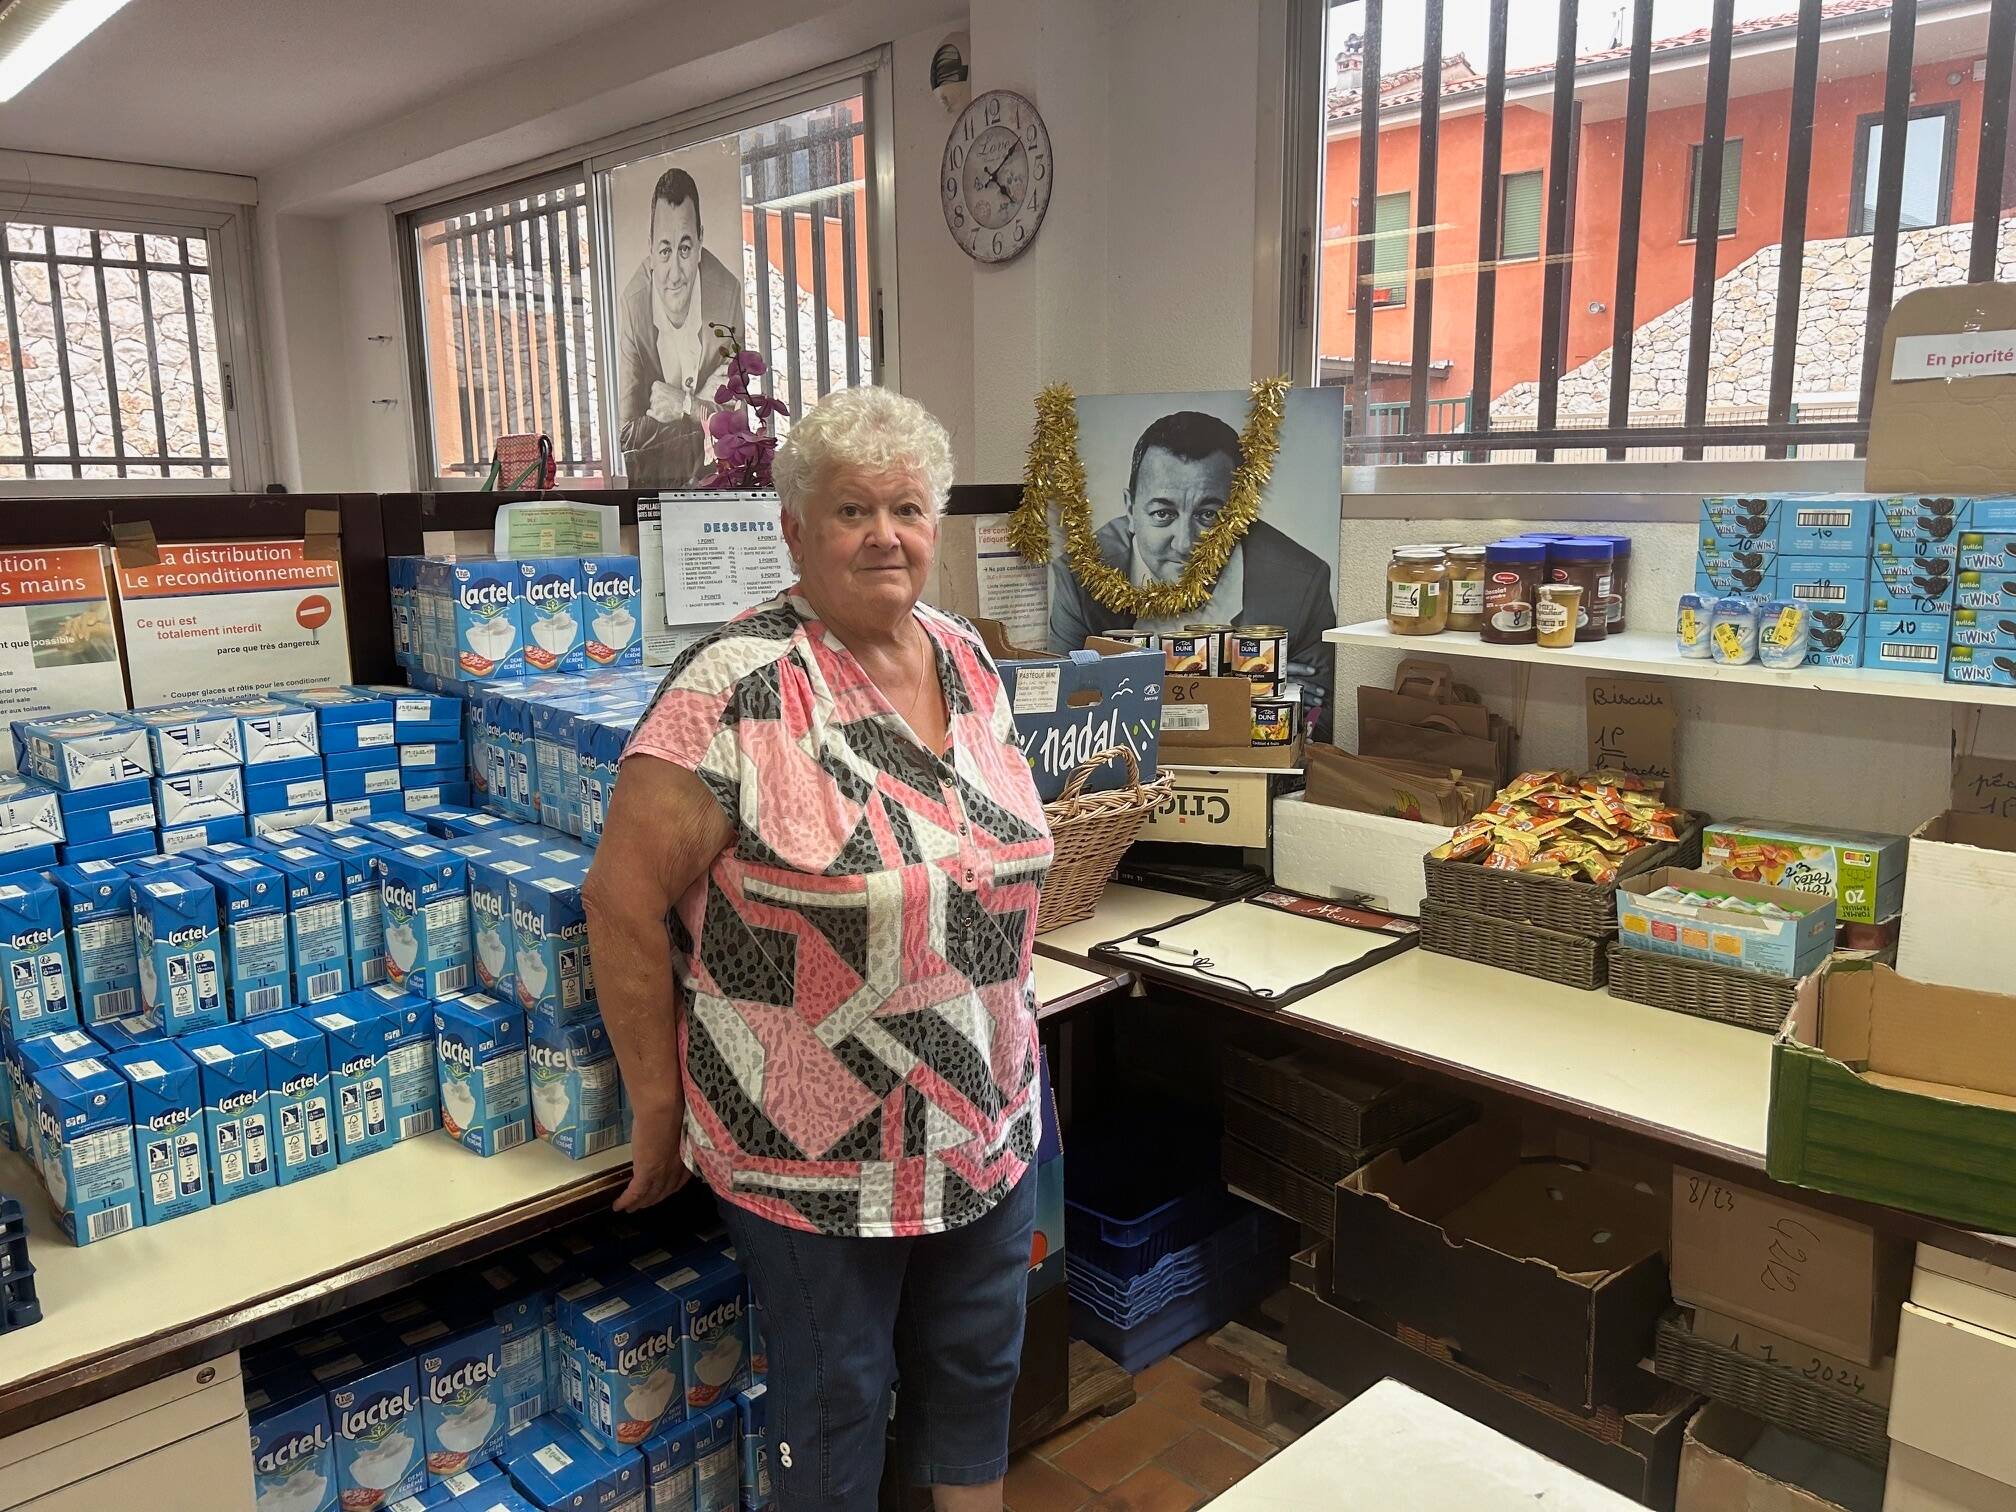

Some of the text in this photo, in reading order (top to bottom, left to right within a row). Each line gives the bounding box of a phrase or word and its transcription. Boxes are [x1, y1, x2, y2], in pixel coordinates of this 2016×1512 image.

[984, 98, 1000, 126] 12
[1015, 104, 1021, 129] 1
[964, 117, 974, 141] 11
[1026, 124, 1038, 150] 2
[950, 145, 963, 171] 10
[1033, 154, 1045, 181] 3
[947, 177, 957, 200] 9
[1027, 185, 1038, 212] 4
[953, 205, 964, 228] 8
[971, 227, 981, 251] 7
[1013, 219, 1024, 241] 5
[992, 232, 1002, 256] 6
[1926, 347, 2014, 367] En priorité
[1712, 505, 1736, 515] TWINS
[1889, 506, 1918, 516] TWINS
[704, 521, 774, 533] DESSERTS
[1717, 524, 1736, 534] WINS
[1811, 528, 1833, 539] 10
[1893, 528, 1917, 538] WINS
[1728, 538, 1752, 550] 10
[1915, 543, 1927, 556] 10
[183, 546, 291, 565] distribution
[1708, 558, 1733, 568] TWINS
[1964, 554, 2004, 569] TWINS
[125, 564, 334, 588] Le reconditionnement
[1884, 566, 1912, 575] TWINS
[20, 577, 86, 593] mains
[588, 576, 636, 601] lactel
[1712, 577, 1732, 587] WINS
[1889, 585, 1911, 594] WINS
[1959, 581, 1980, 589] gullón
[460, 582, 516, 610] lactel
[526, 578, 577, 605] lactel
[1411, 588, 1418, 606] 6
[1960, 592, 2000, 607] TWINS
[137, 616, 197, 628] Ce qui est
[1514, 610, 1521, 625] 8
[157, 623, 262, 639] totalement interdit
[1888, 621, 1916, 635] 10
[1957, 630, 1997, 644] TWINS
[10, 640, 29, 653] que
[32, 636, 75, 648] possible
[217, 645, 240, 655] parce
[242, 644, 258, 654] que
[278, 640, 320, 650] dangereux
[1826, 655, 1854, 665] TWINS
[1953, 666, 1992, 681] TWINS
[15, 685, 37, 694] propre
[170, 690, 199, 700] Couper
[201, 687, 226, 697] glaces
[255, 682, 272, 690] pour
[286, 676, 330, 687] conditionner
[1040, 708, 1118, 776] nadal
[608, 760, 620, 774] lac
[381, 879, 418, 915] lactel
[471, 884, 504, 921] lactel
[1844, 889, 1867, 904] 20
[511, 901, 547, 941] lactel
[11, 928, 54, 950] lactel
[168, 925, 208, 946] lactel
[561, 923, 588, 940] lacte
[318, 962, 328, 971] 1L
[106, 981, 118, 990] 1L
[257, 978, 269, 988] 1L
[437, 1033, 475, 1072] lactel
[341, 1054, 377, 1077] lactel
[282, 1073, 319, 1096] lactel
[218, 1090, 258, 1113] lactel
[411, 1103, 421, 1113] 1L
[149, 1107, 191, 1131] lactel
[503, 1114, 513, 1123] 1L
[102, 1196, 114, 1209] 1L
[689, 1295, 744, 1342] lactel
[617, 1326, 676, 1375] lactel
[429, 1353, 496, 1403] lactel
[1802, 1358, 1865, 1394] 2024
[341, 1385, 414, 1440] lactel
